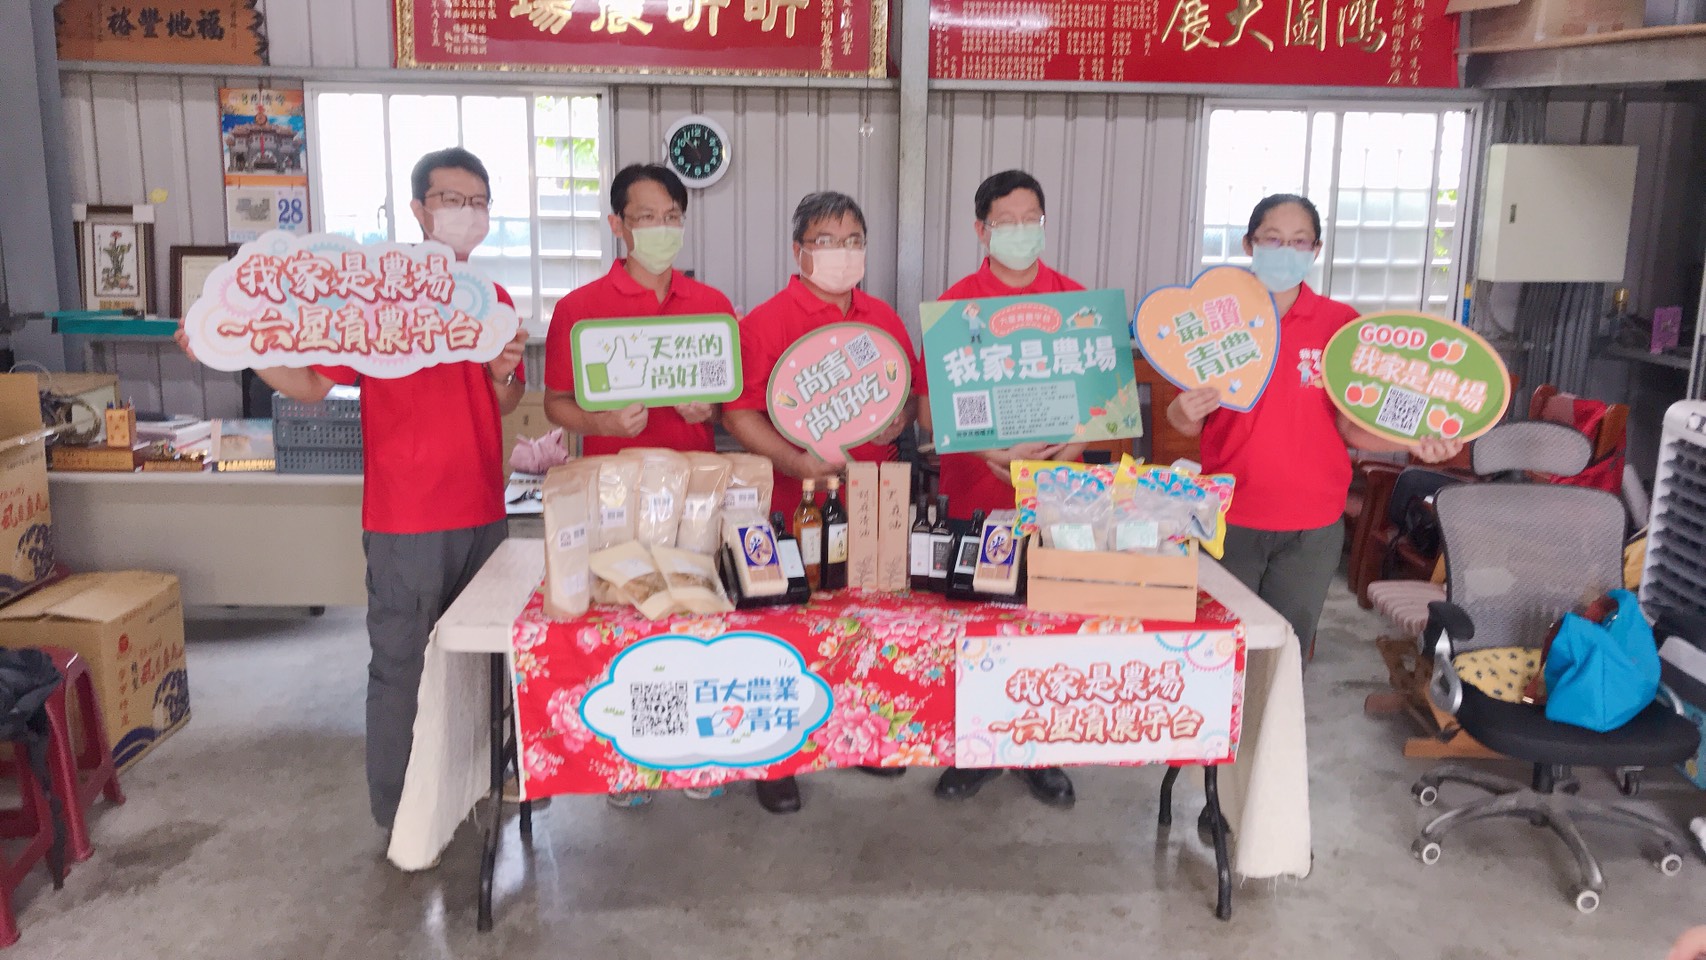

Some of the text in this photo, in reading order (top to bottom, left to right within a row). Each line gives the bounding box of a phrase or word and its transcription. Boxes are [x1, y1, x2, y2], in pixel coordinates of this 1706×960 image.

[278, 198, 304, 225] 28
[237, 249, 456, 303] 我家是農場
[648, 333, 723, 360] 天然的
[1185, 330, 1263, 384] 青農
[1358, 323, 1428, 349] GOOD
[651, 363, 699, 390] 尚好
[794, 349, 852, 403] 尚青
[943, 335, 1117, 387] 我家是農場
[1351, 344, 1489, 414] 我家是農場
[804, 372, 890, 441] 尚好吃
[693, 675, 801, 704] 百大農業
[1005, 660, 1185, 706] 我家是農場
[748, 706, 800, 732] 青年
